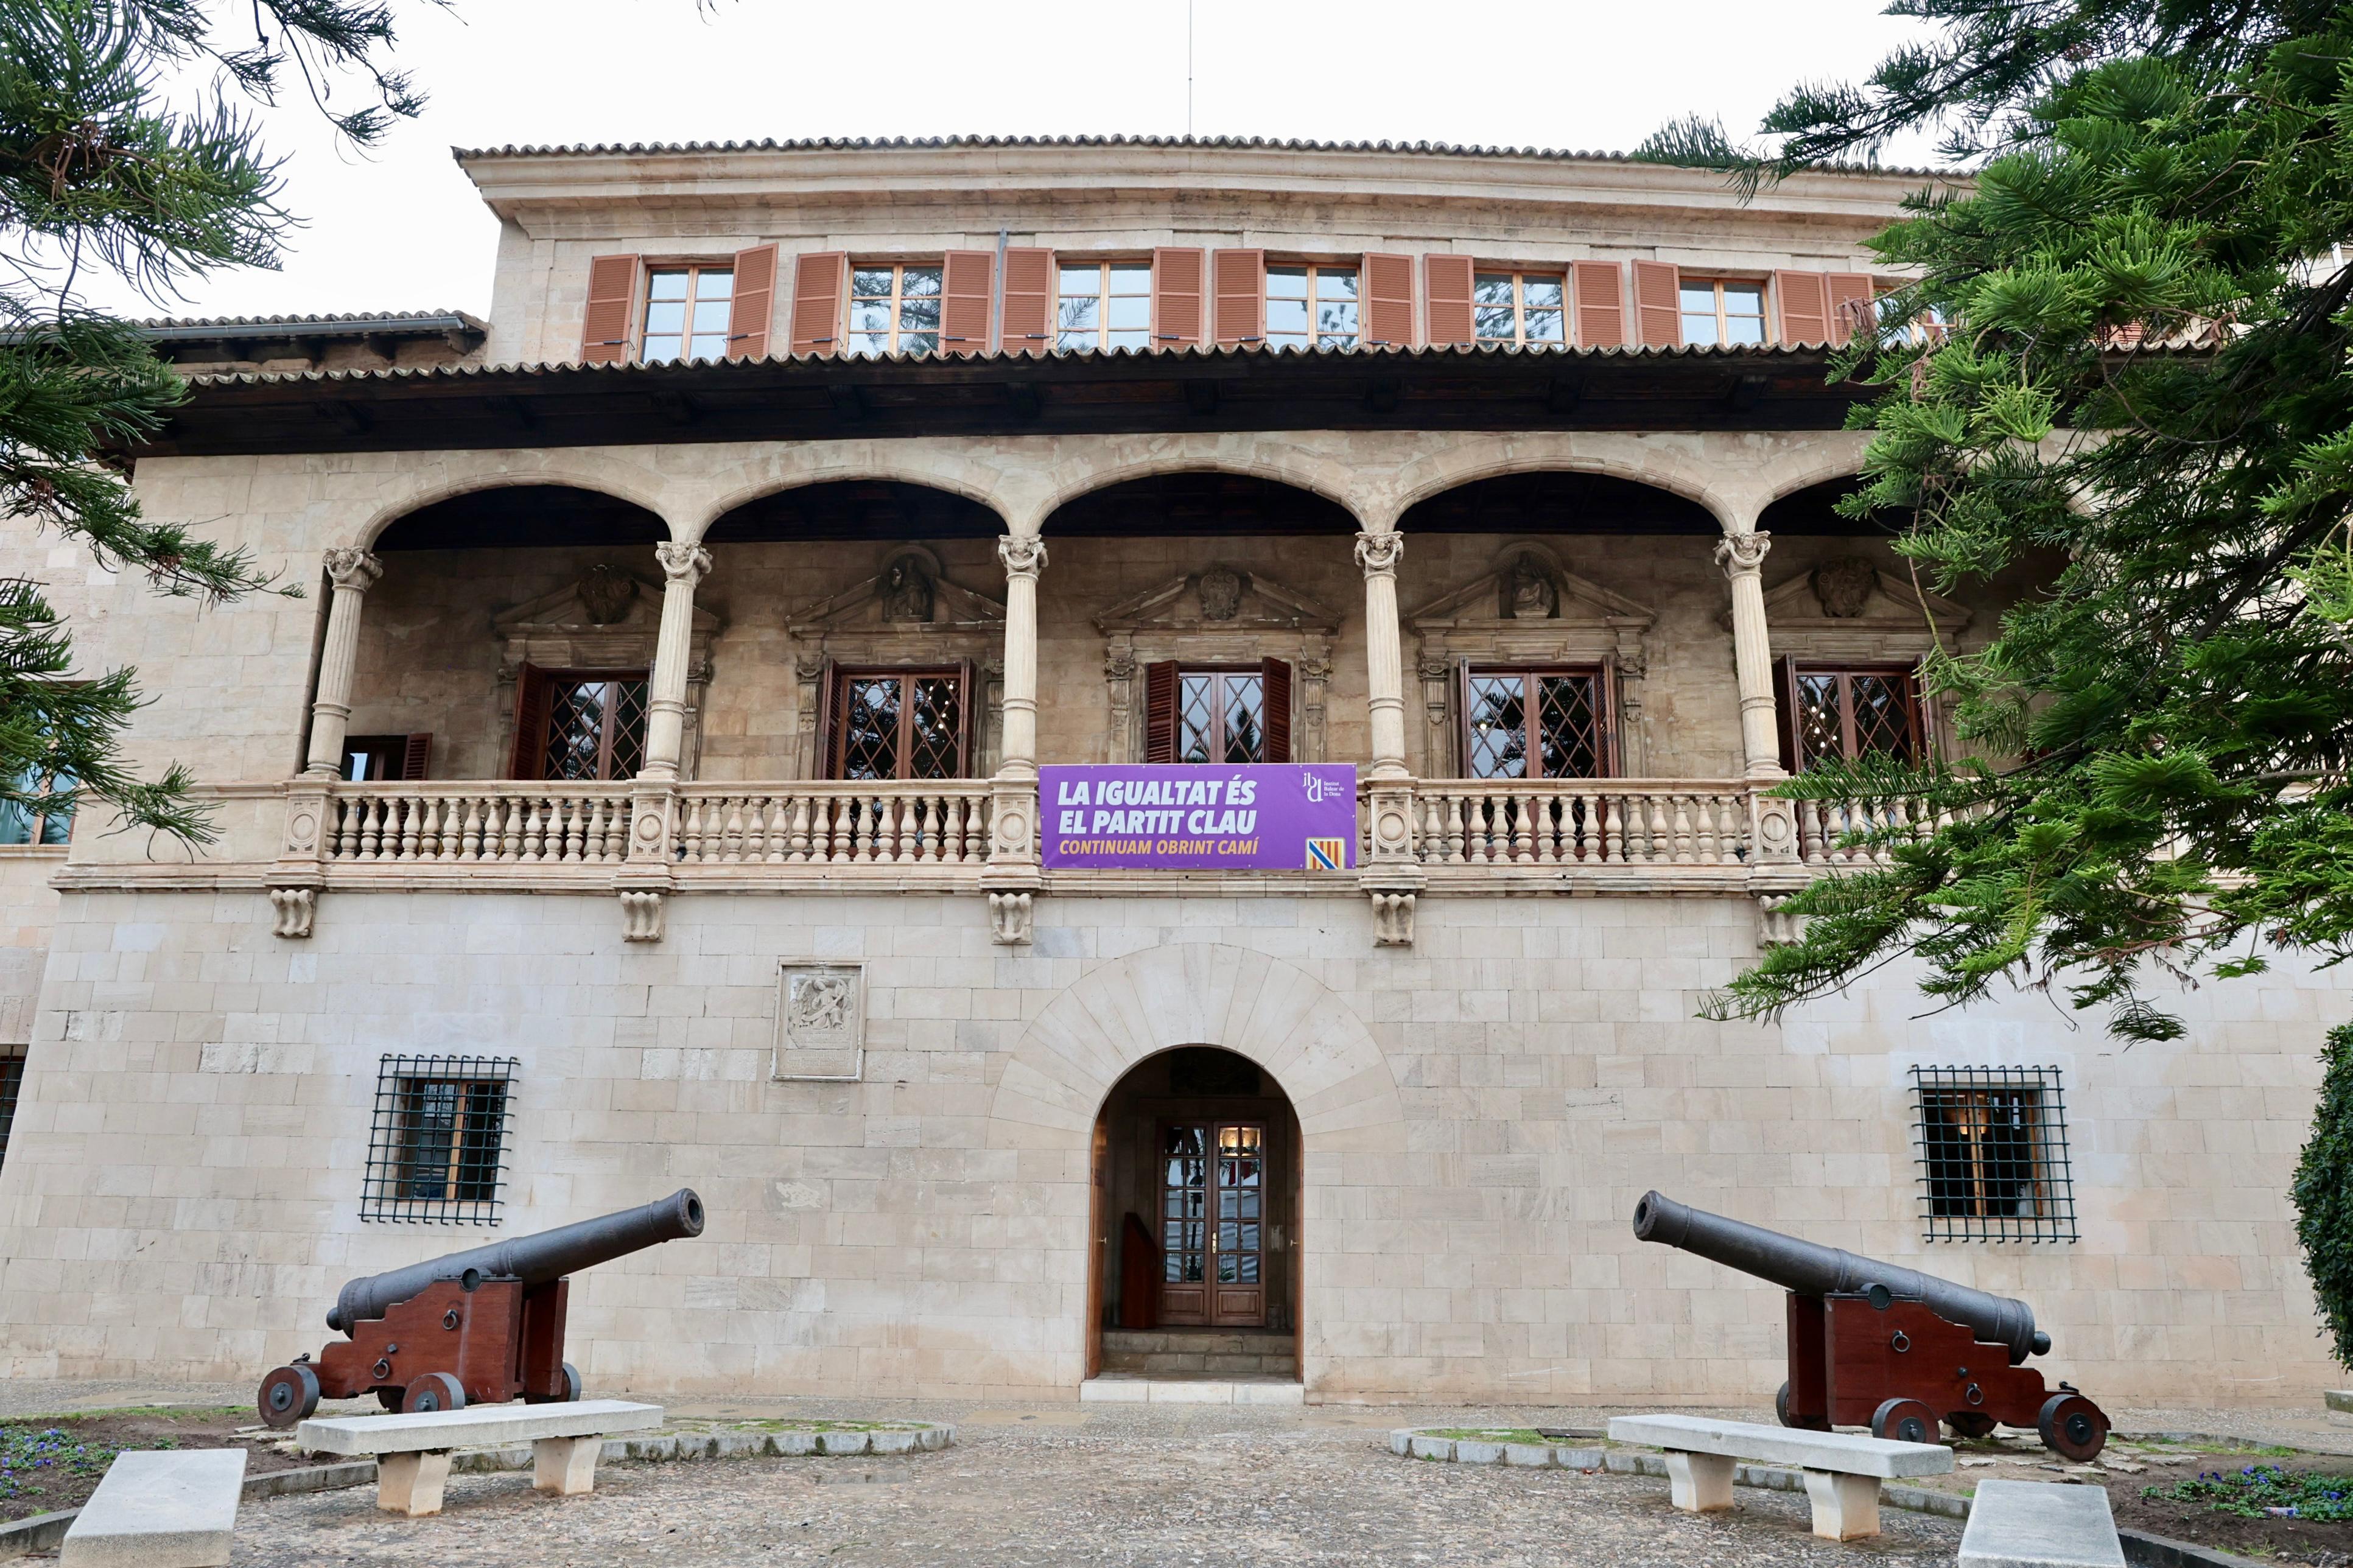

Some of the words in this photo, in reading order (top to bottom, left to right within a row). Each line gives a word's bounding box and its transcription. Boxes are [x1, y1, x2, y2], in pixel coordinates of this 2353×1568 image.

[1057, 781, 1090, 805] LA
[1095, 780, 1223, 805] IGUALTAT
[1225, 774, 1258, 805] ÉS
[1059, 810, 1087, 834] EL
[1092, 810, 1185, 834] PARTIT
[1187, 810, 1257, 835] CLAU
[1059, 839, 1152, 855] CONTINUAM
[1156, 839, 1215, 855] OBRINT
[1218, 836, 1259, 855] CAMÍ
